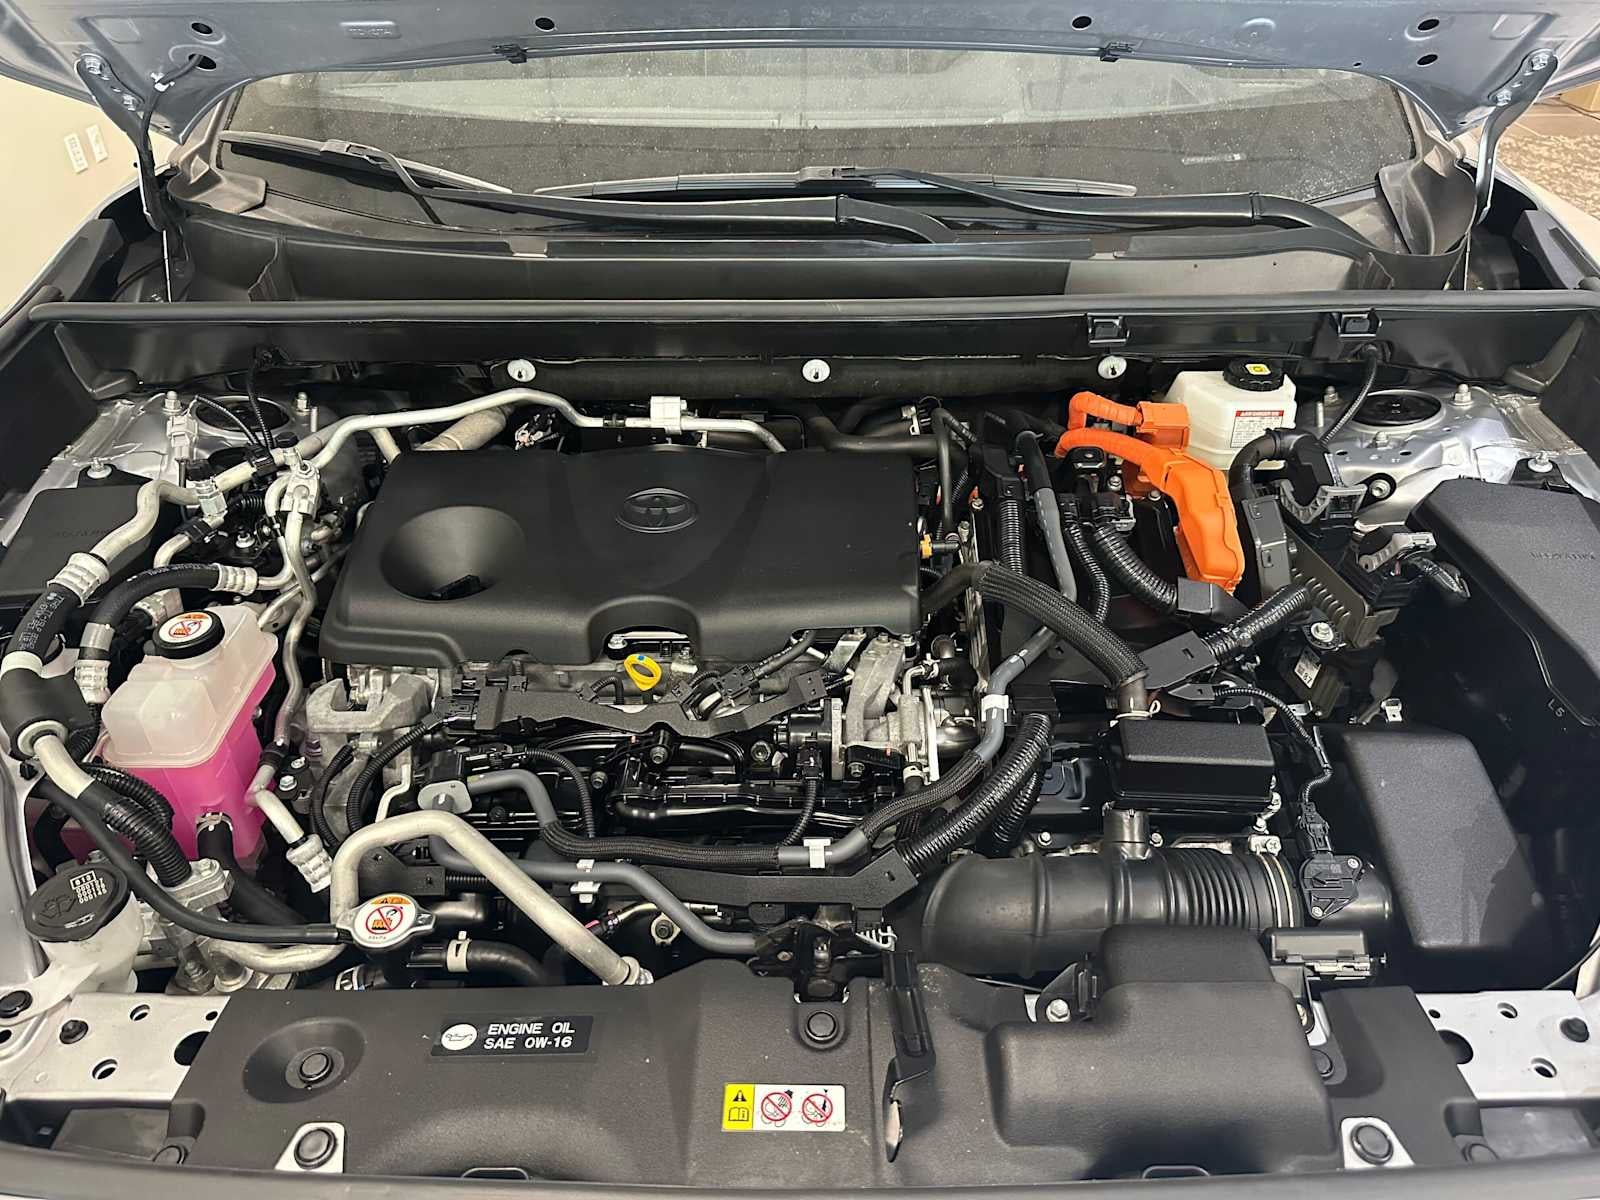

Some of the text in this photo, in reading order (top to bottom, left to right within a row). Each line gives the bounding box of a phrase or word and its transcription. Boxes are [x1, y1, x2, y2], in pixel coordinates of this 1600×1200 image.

[487, 1021, 576, 1035] ENGINE OIL
[483, 1036, 573, 1050] SAE 0W-16
